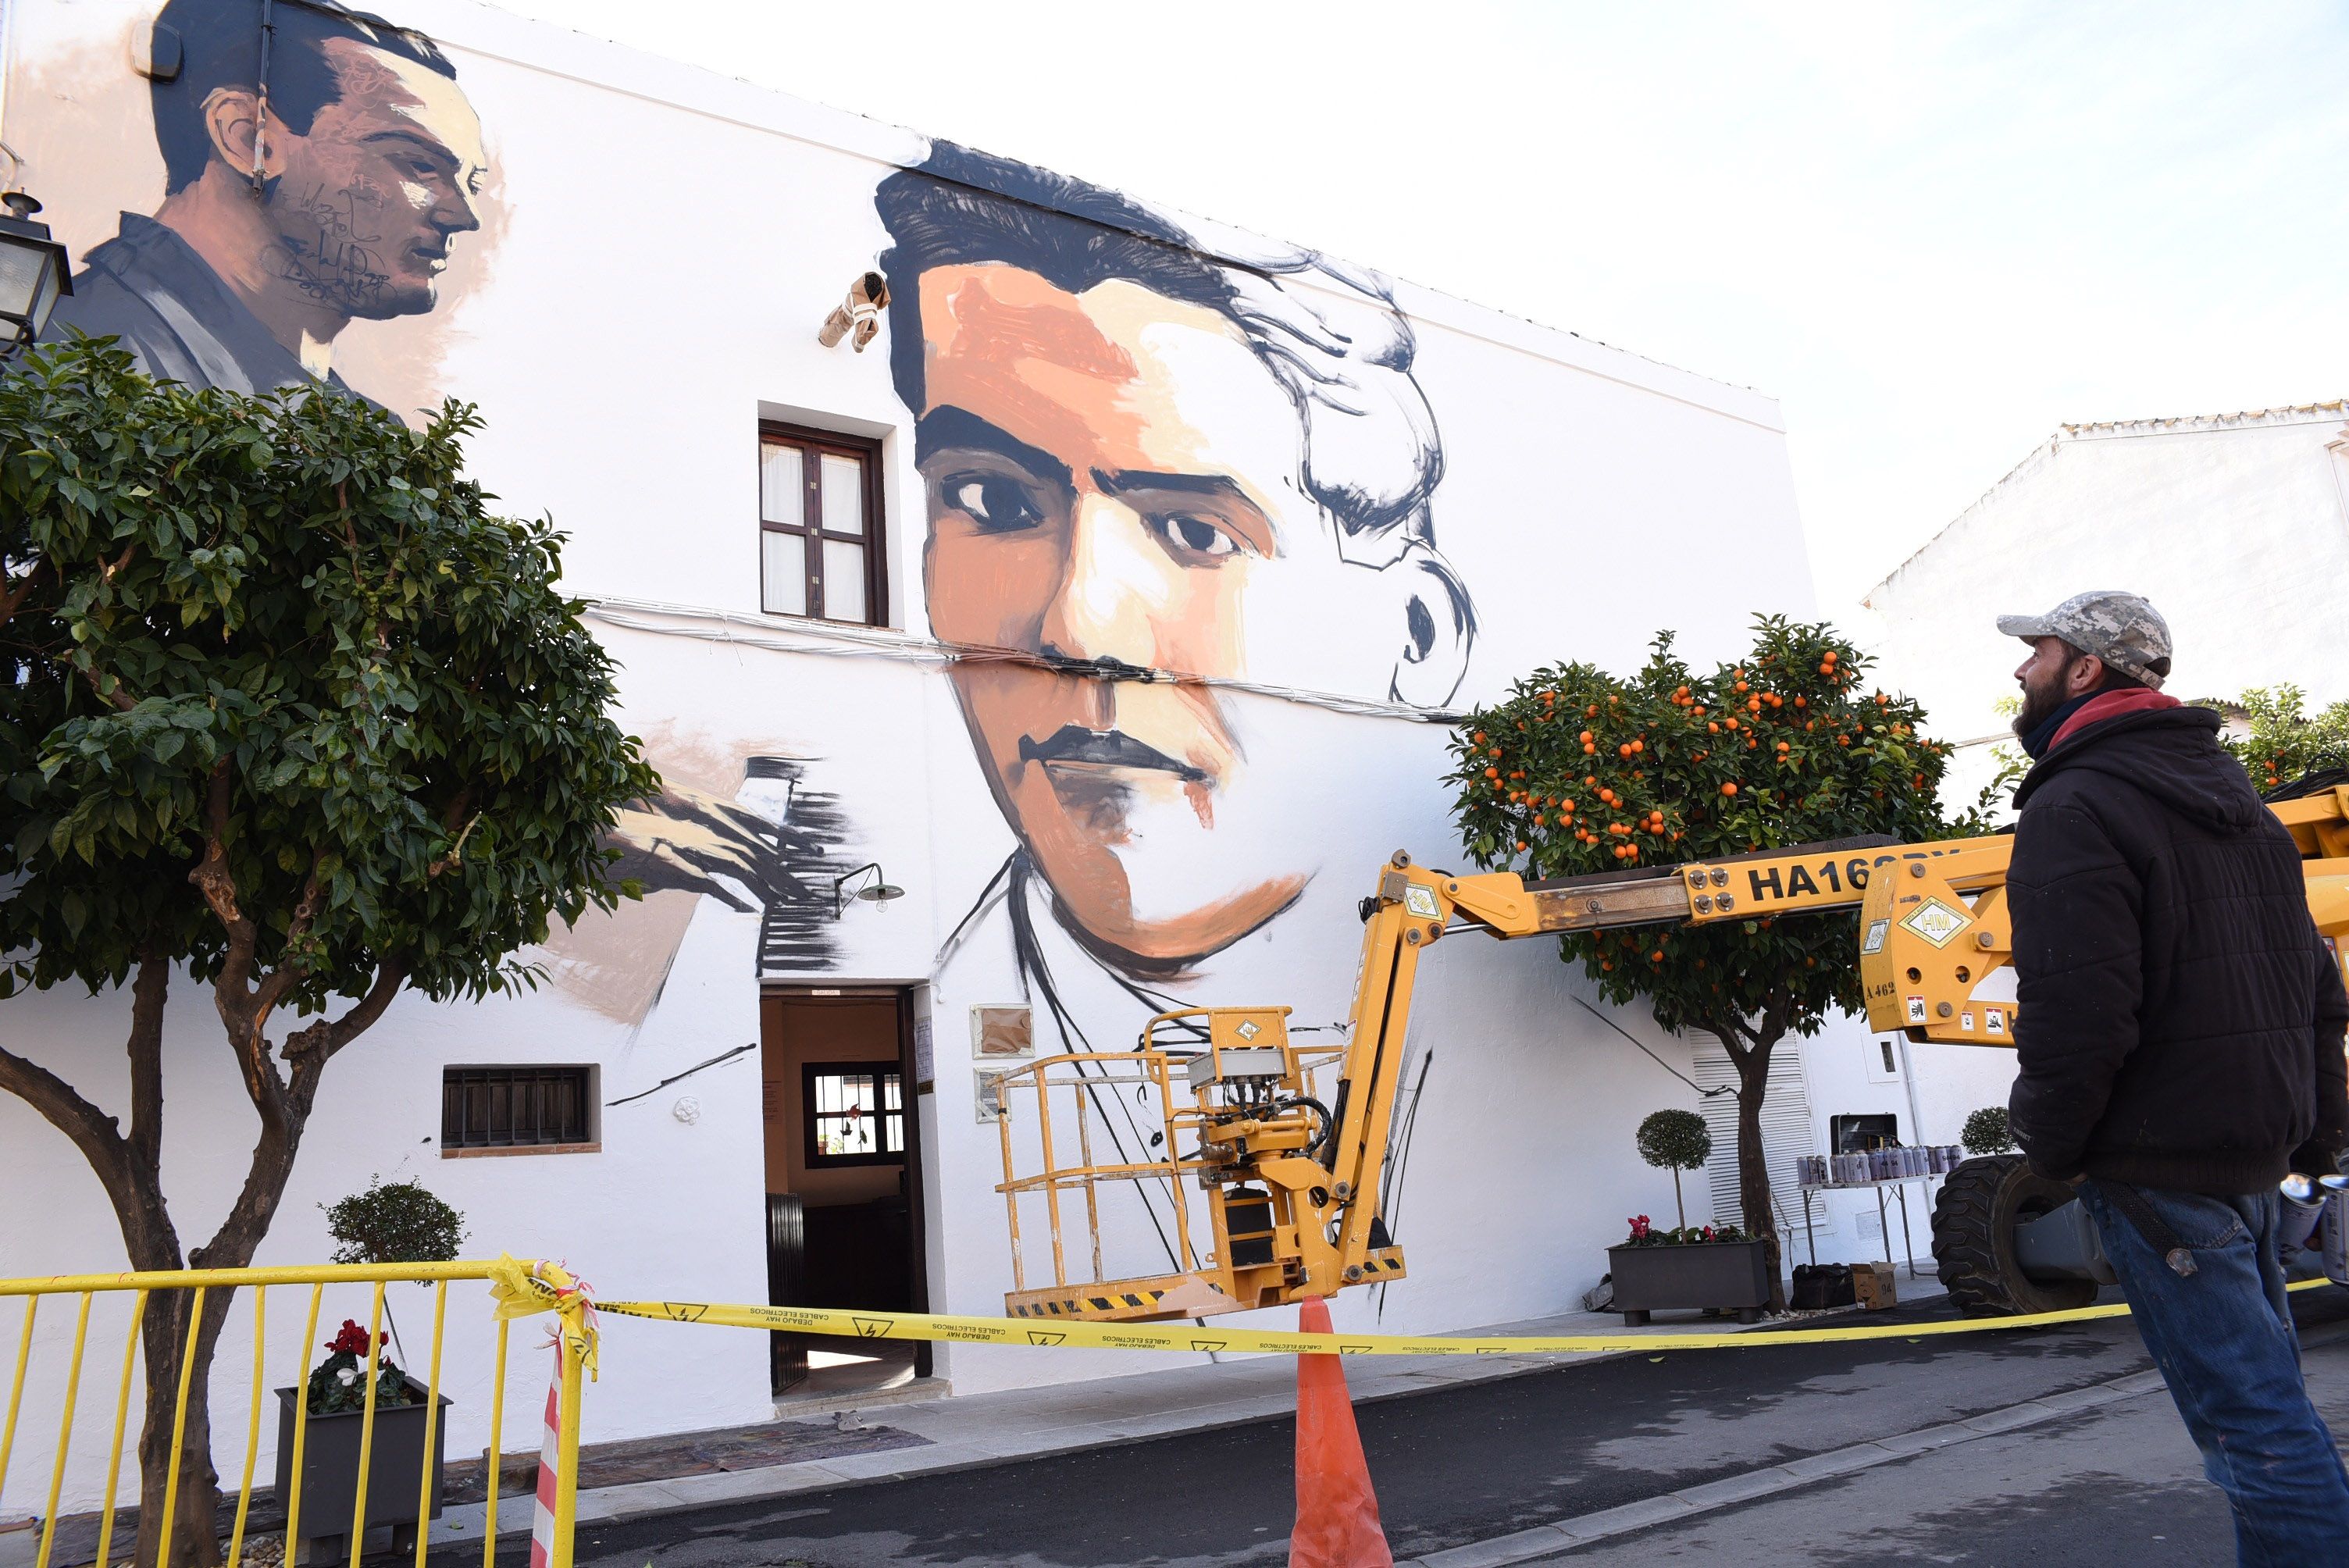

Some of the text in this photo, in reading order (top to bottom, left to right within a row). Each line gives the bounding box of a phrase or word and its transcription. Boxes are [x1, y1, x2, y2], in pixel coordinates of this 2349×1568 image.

[1409, 889, 1432, 912] HM
[1921, 914, 1951, 931] HM
[1866, 982, 1895, 1000] A 462
[750, 1308, 797, 1317] ELECTRICOS
[782, 1317, 813, 1326] DEBAJO
[932, 1324, 976, 1332] ELECTRICOS
